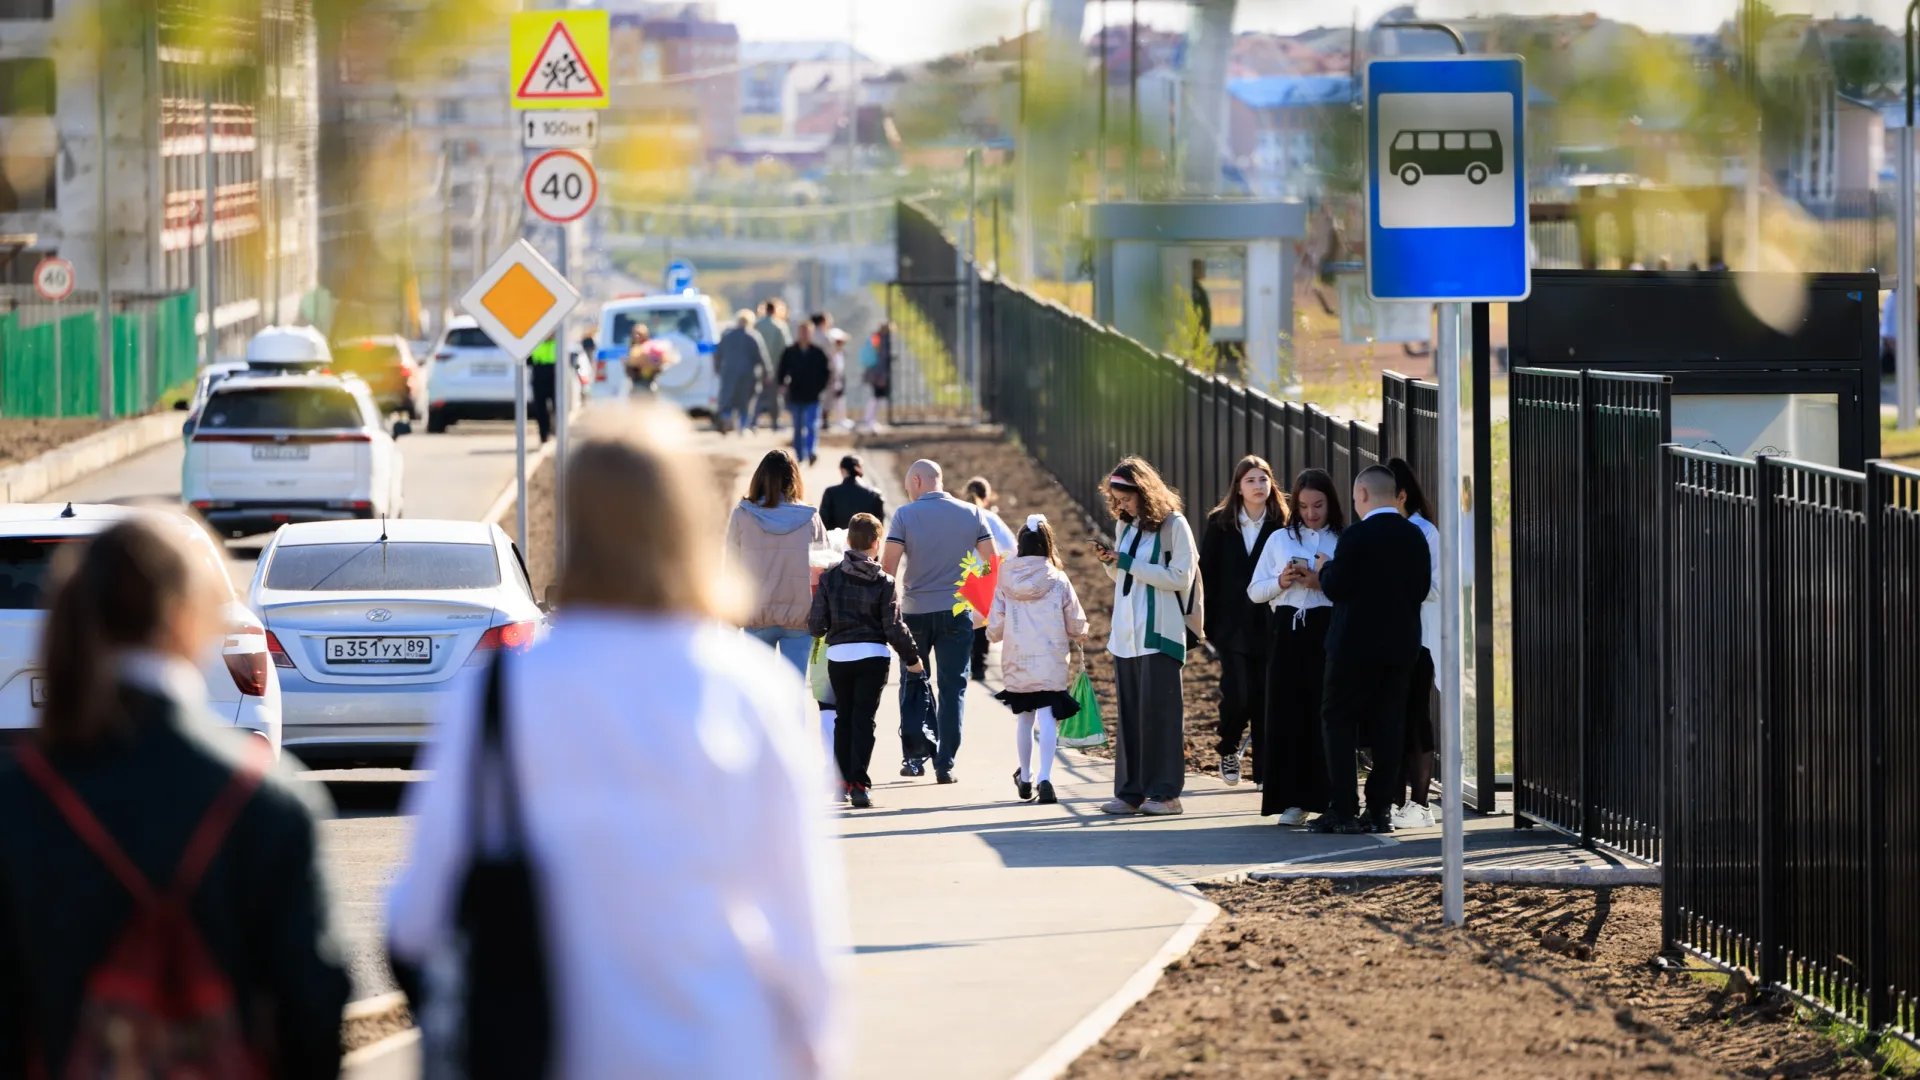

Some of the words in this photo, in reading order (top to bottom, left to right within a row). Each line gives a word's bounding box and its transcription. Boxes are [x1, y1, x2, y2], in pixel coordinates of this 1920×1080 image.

[540, 172, 582, 200] 40
[43, 269, 67, 288] 40
[407, 640, 425, 653] 89
